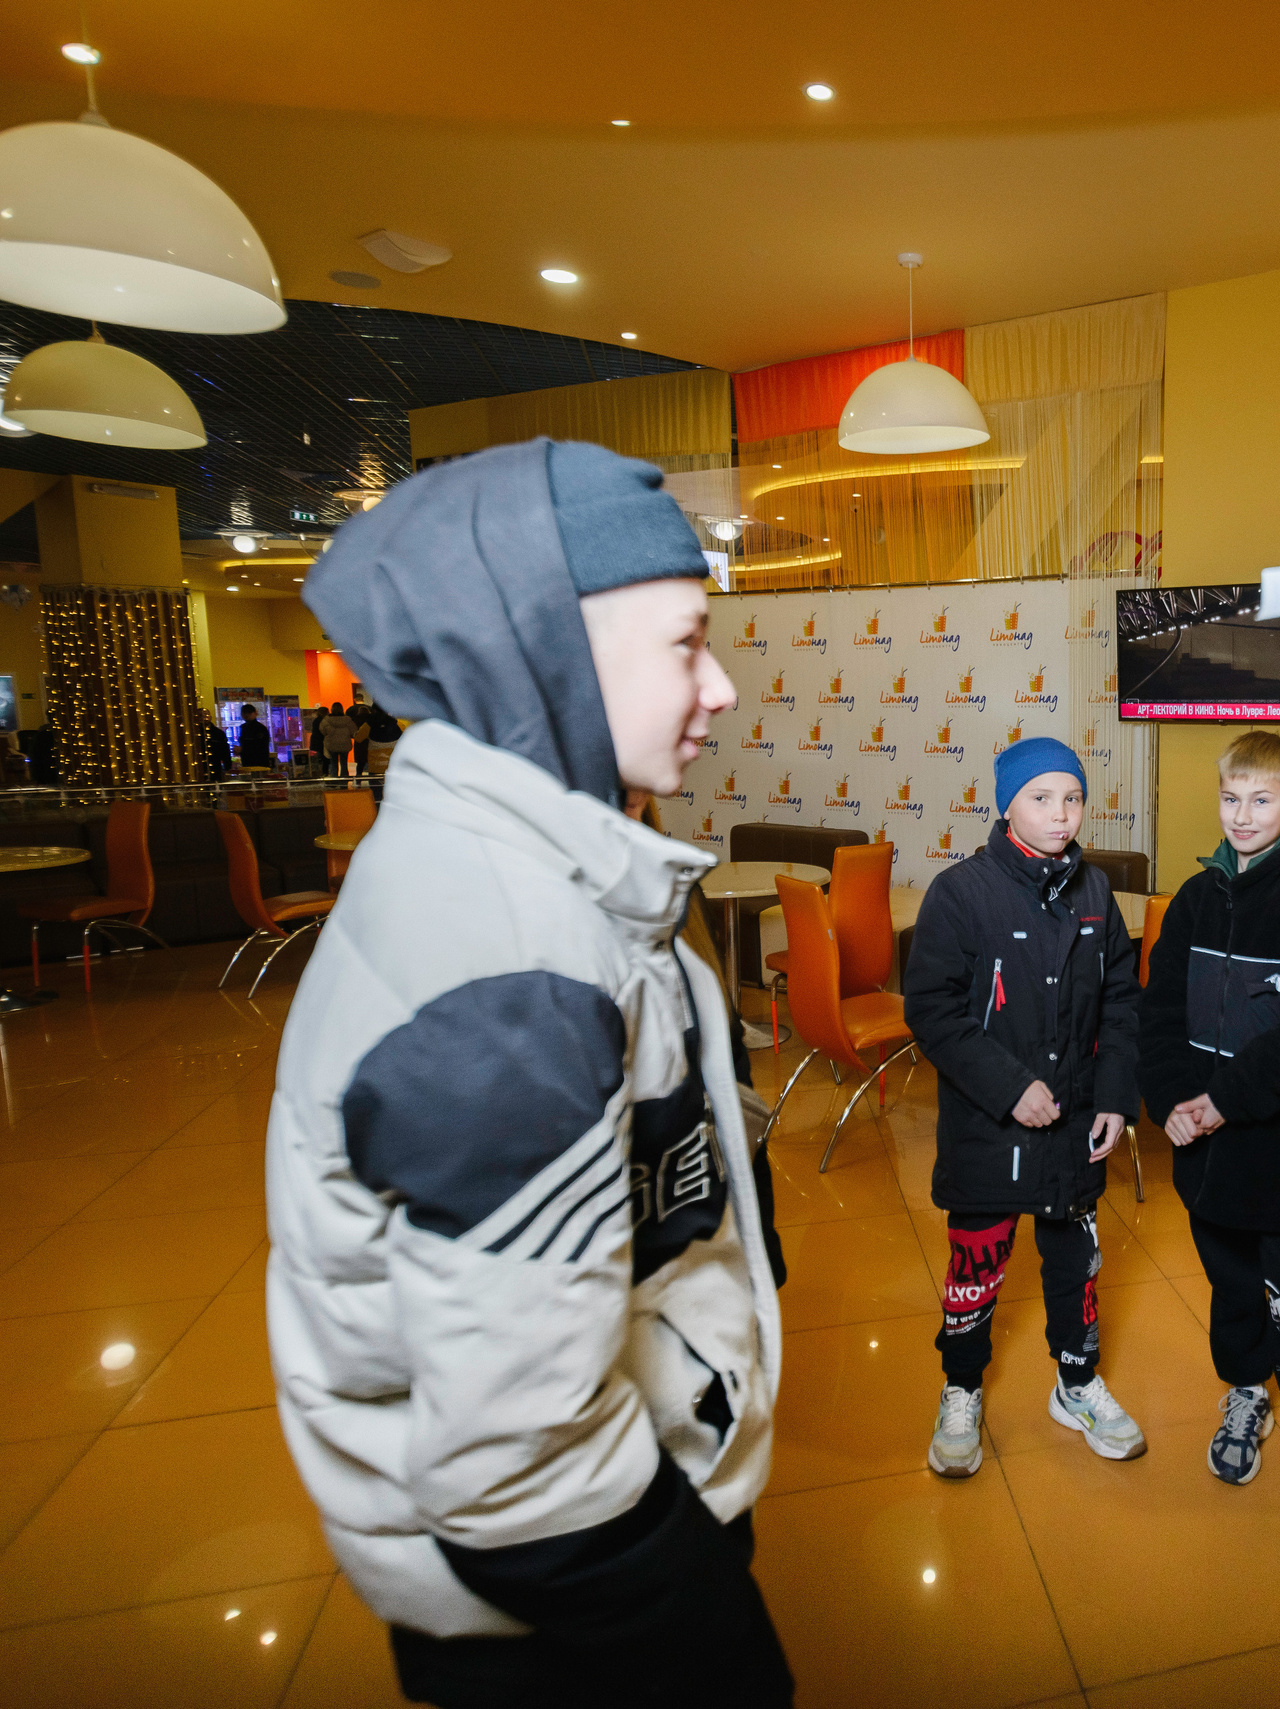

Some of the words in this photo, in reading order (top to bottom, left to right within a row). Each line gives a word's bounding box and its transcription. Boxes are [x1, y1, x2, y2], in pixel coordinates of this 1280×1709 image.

[1138, 703, 1187, 715] АРТ-ЛЕКТОРИЙ
[1188, 705, 1193, 715] В
[1195, 705, 1216, 715] КИНО:
[1217, 705, 1234, 715] Ночь
[1241, 706, 1266, 718] Лувре:
